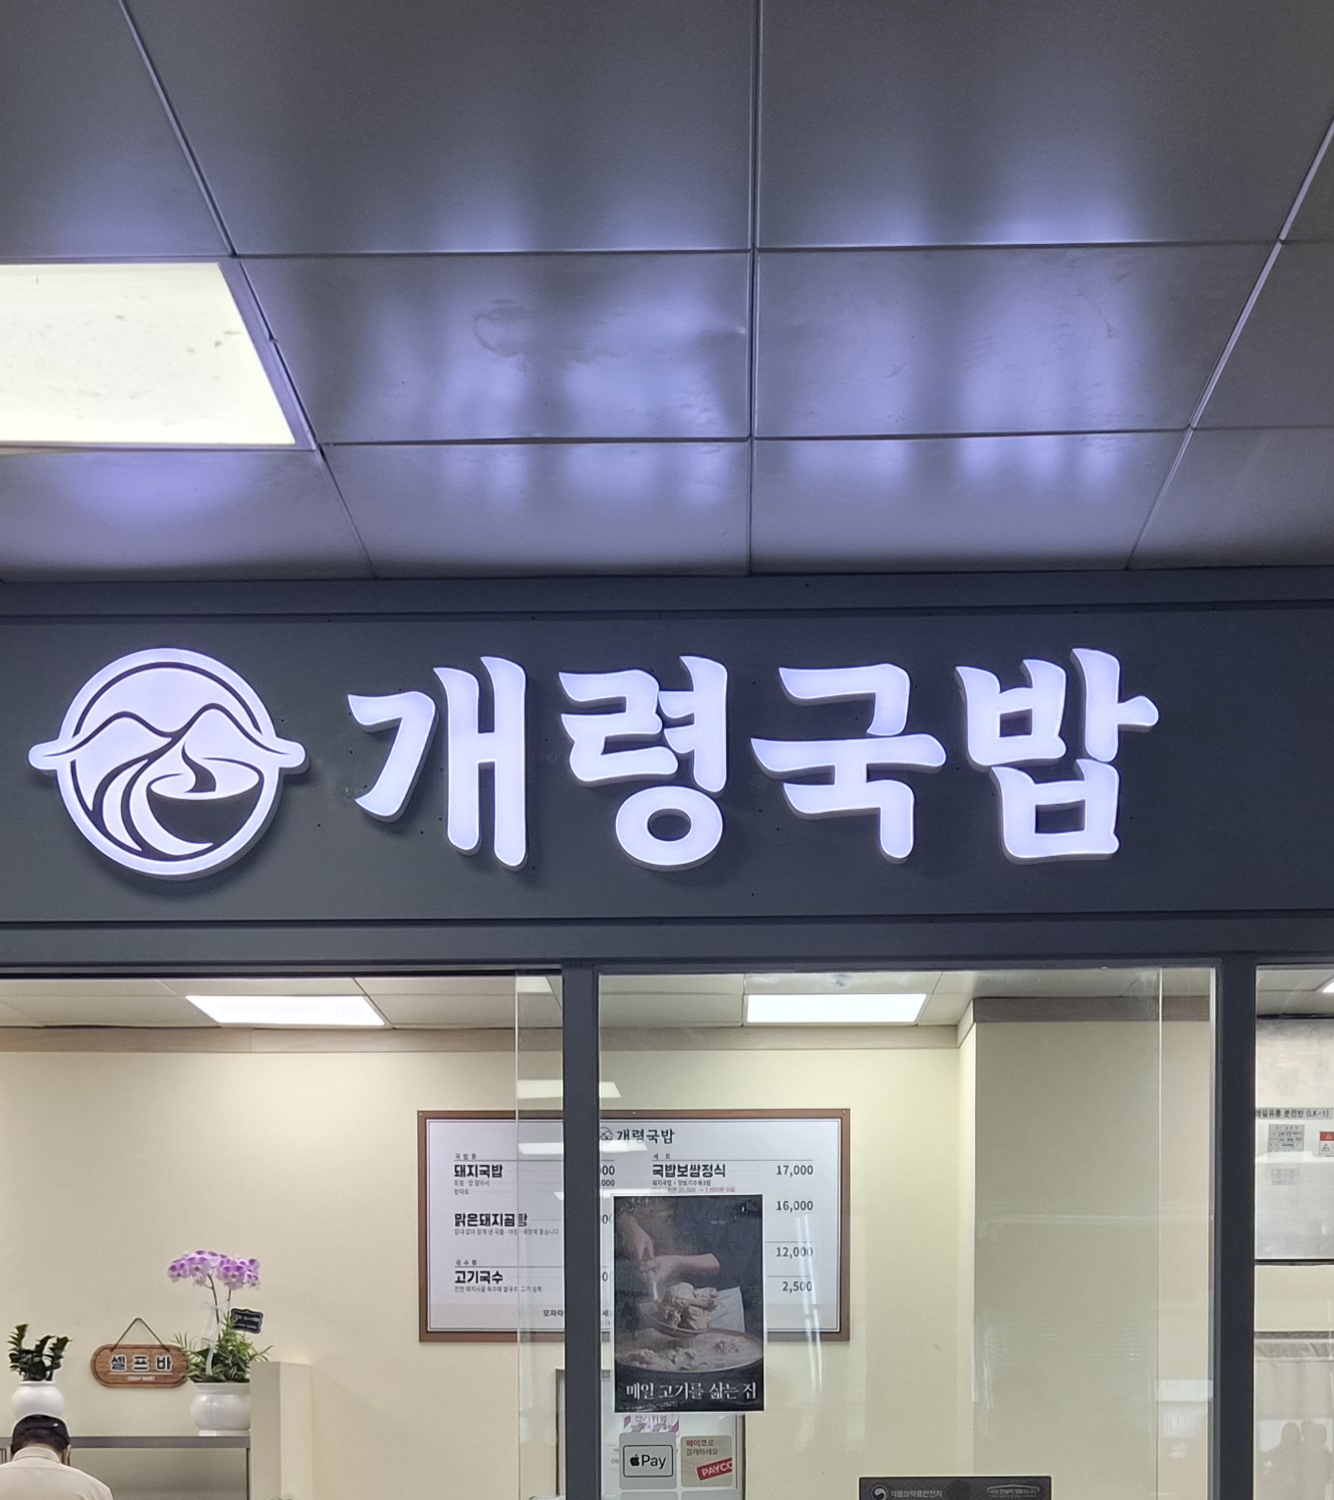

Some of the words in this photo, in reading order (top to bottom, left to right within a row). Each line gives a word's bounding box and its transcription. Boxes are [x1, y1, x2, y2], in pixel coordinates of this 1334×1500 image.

[344, 647, 1158, 869] 개령국밥
[617, 1128, 675, 1144] 개령국밥
[454, 1164, 503, 1178] 돼지국밥
[652, 1164, 726, 1178] 국밥보쌈정식
[776, 1165, 814, 1177] 17,000
[776, 1201, 814, 1212] 16,000
[454, 1212, 528, 1227] 맑은돼지곰탕
[776, 1247, 814, 1258] 12,000
[454, 1270, 504, 1284] 고기국수
[782, 1281, 813, 1292] 2,500
[111, 1354, 173, 1371] 셀프바
[626, 1382, 655, 1400] 매일
[659, 1382, 704, 1400] 고기를
[709, 1382, 739, 1400] 삶는
[743, 1382, 757, 1400] 집
[641, 1454, 666, 1470] Pay
